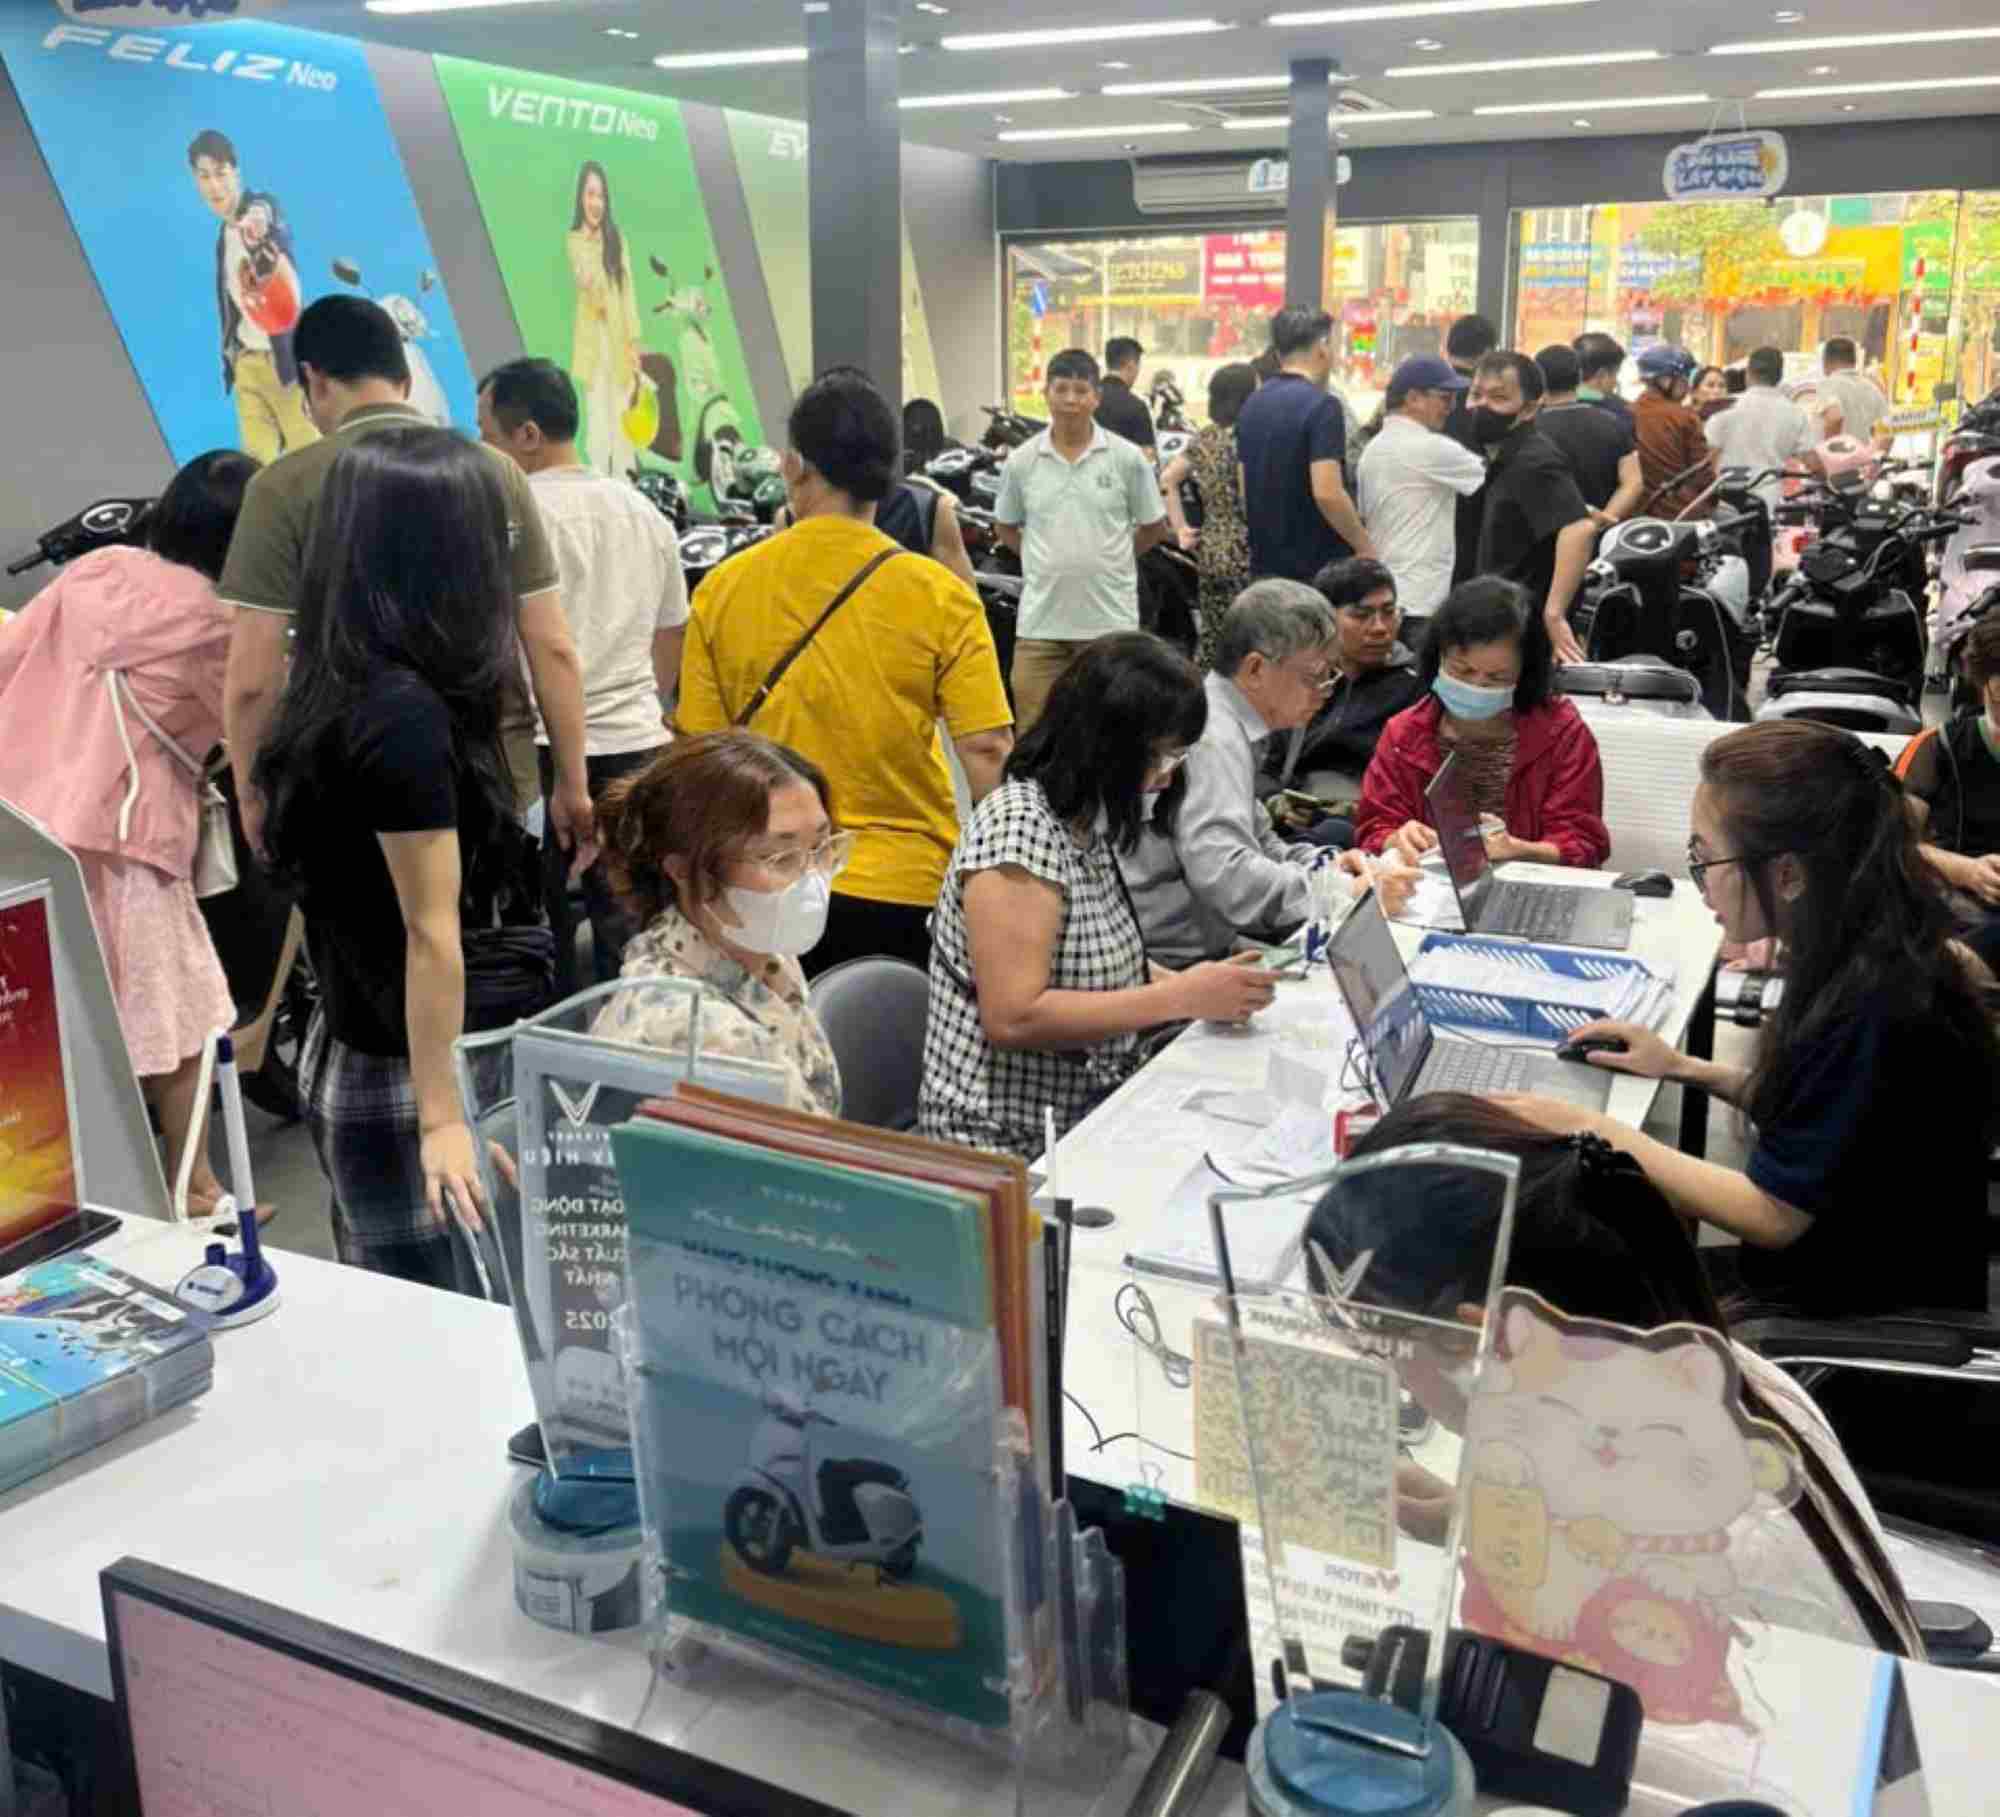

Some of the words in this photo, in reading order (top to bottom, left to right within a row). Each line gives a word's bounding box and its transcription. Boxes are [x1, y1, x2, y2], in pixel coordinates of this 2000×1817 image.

[42, 24, 286, 81] FELIZ
[286, 60, 337, 91] Neo
[486, 82, 616, 136] VENTO
[617, 106, 659, 141] Neo
[673, 1270, 803, 1335] PHONG
